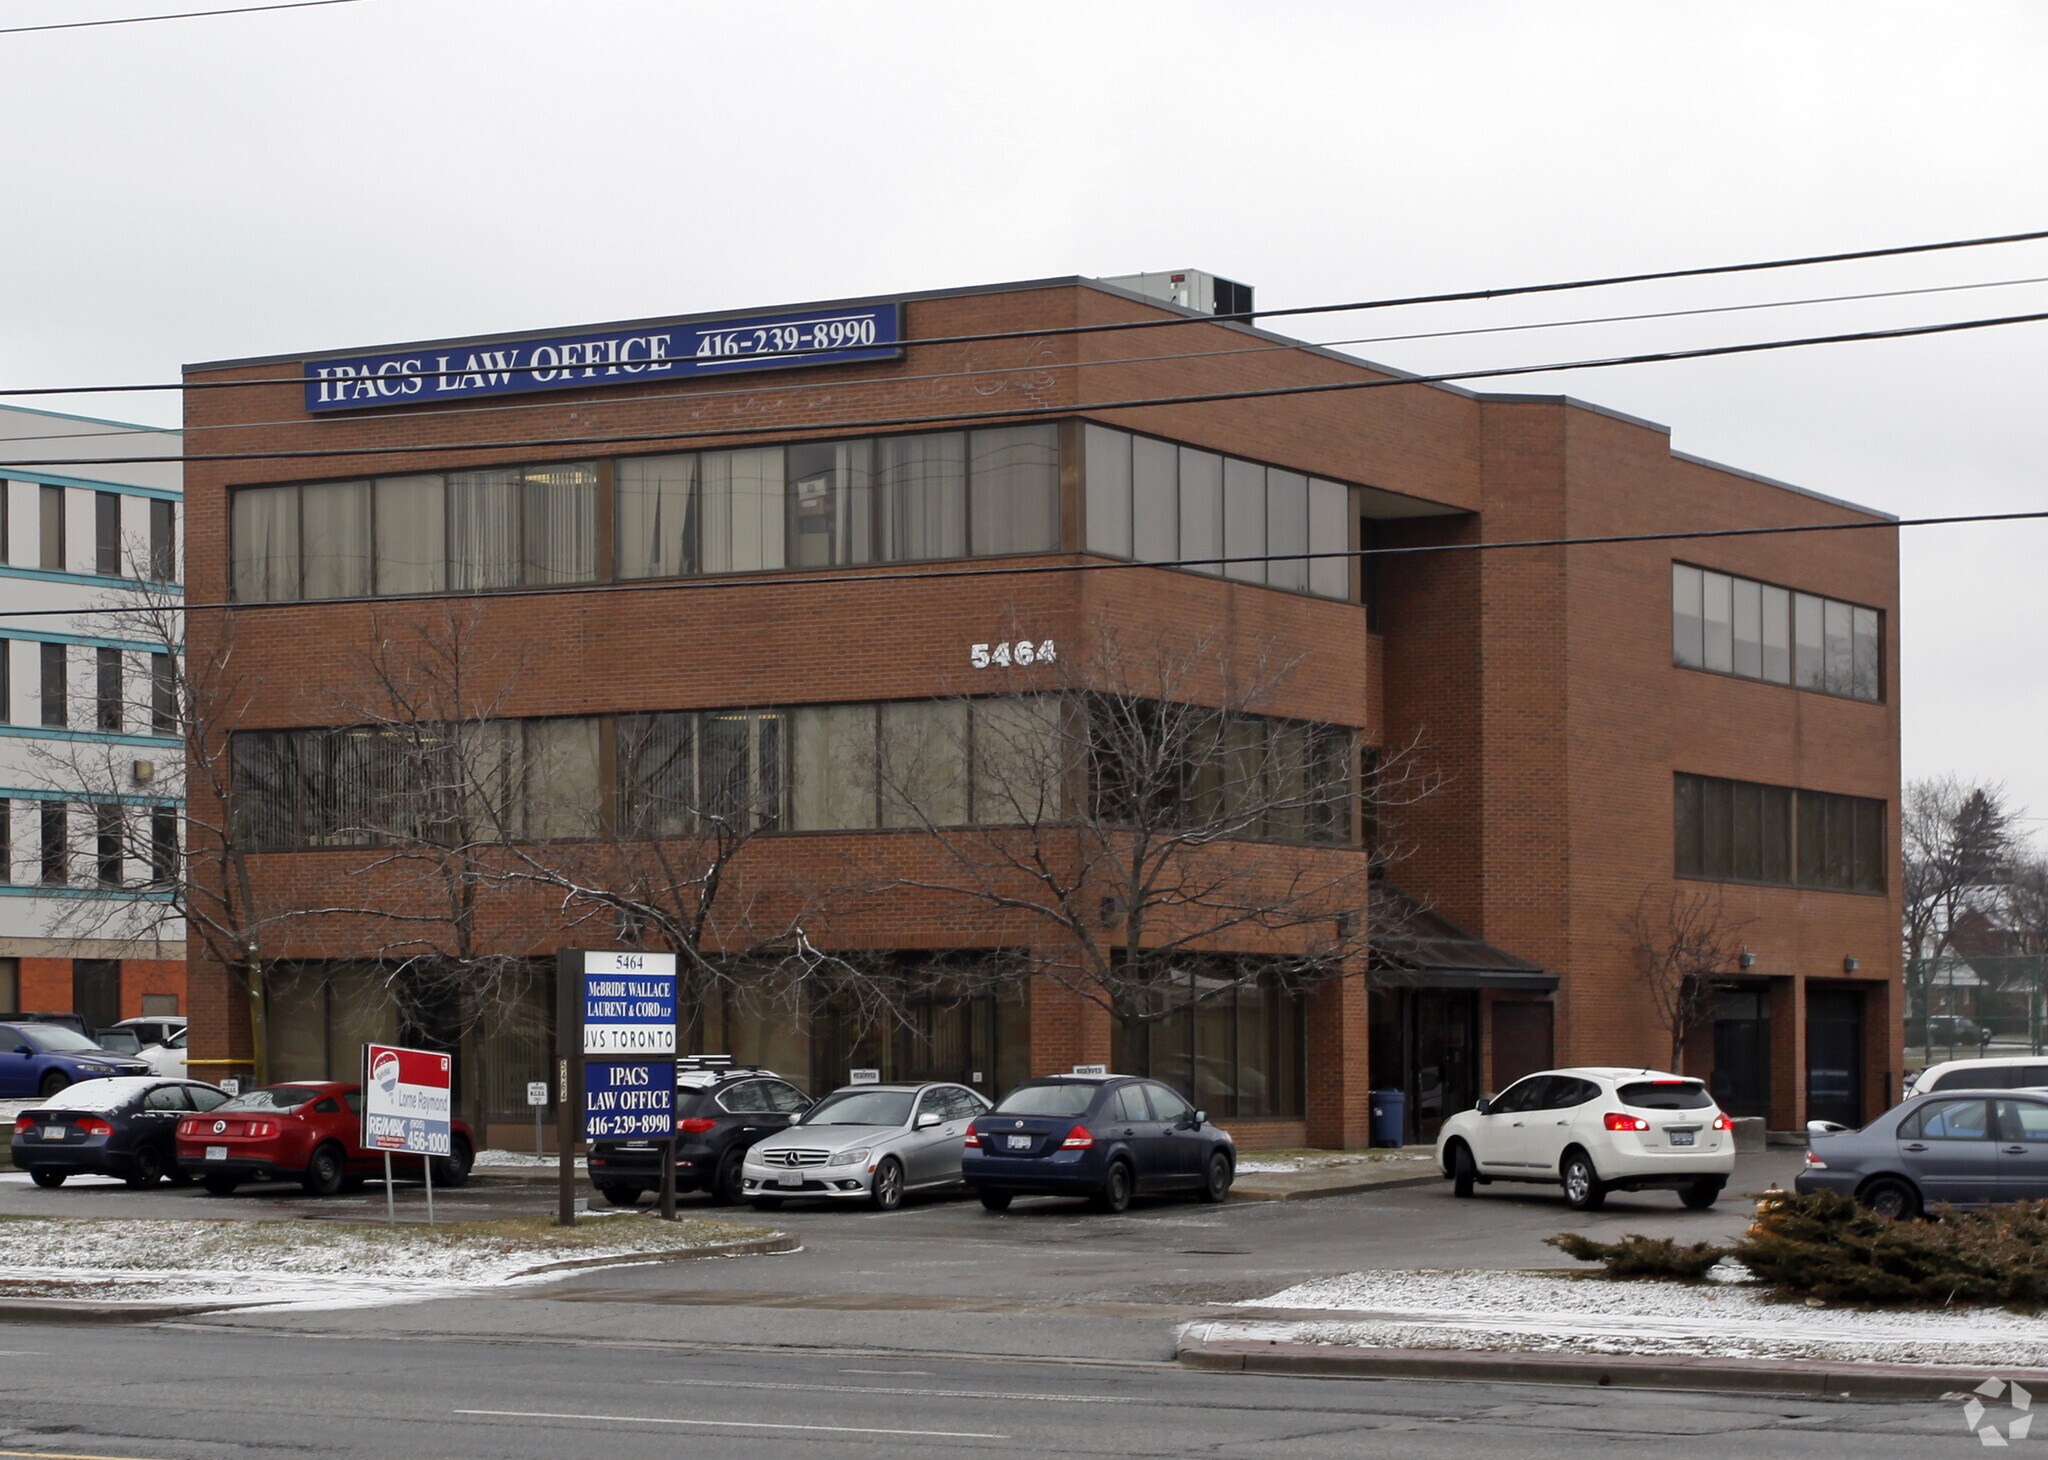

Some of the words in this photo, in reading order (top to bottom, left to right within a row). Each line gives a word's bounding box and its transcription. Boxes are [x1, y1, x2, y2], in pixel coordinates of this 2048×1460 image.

[317, 358, 422, 402] IPACS
[436, 350, 518, 391] LAW
[530, 334, 671, 381] OFFICE
[697, 319, 876, 359] 416-239-8990
[971, 640, 1056, 668] 5464
[616, 955, 643, 969] 5464
[588, 981, 626, 997] McBRIDE
[628, 982, 670, 997] WALLACE
[587, 1001, 626, 1017] LAURENT
[628, 1005, 634, 1017] &
[635, 1002, 660, 1017] CORD
[661, 1008, 671, 1017] LLP
[585, 1030, 605, 1048] JVS
[612, 1030, 673, 1048] TORONTO
[609, 1067, 649, 1086] IPACS
[399, 1089, 416, 1109] Lorne
[418, 1091, 448, 1115] Raymond
[587, 1092, 617, 1111] LAW
[620, 1090, 670, 1109] OFFICE
[369, 1116, 405, 1137] RE/MAX
[586, 1114, 670, 1135] 416-239-8990
[407, 1131, 448, 1152] 456-1000
